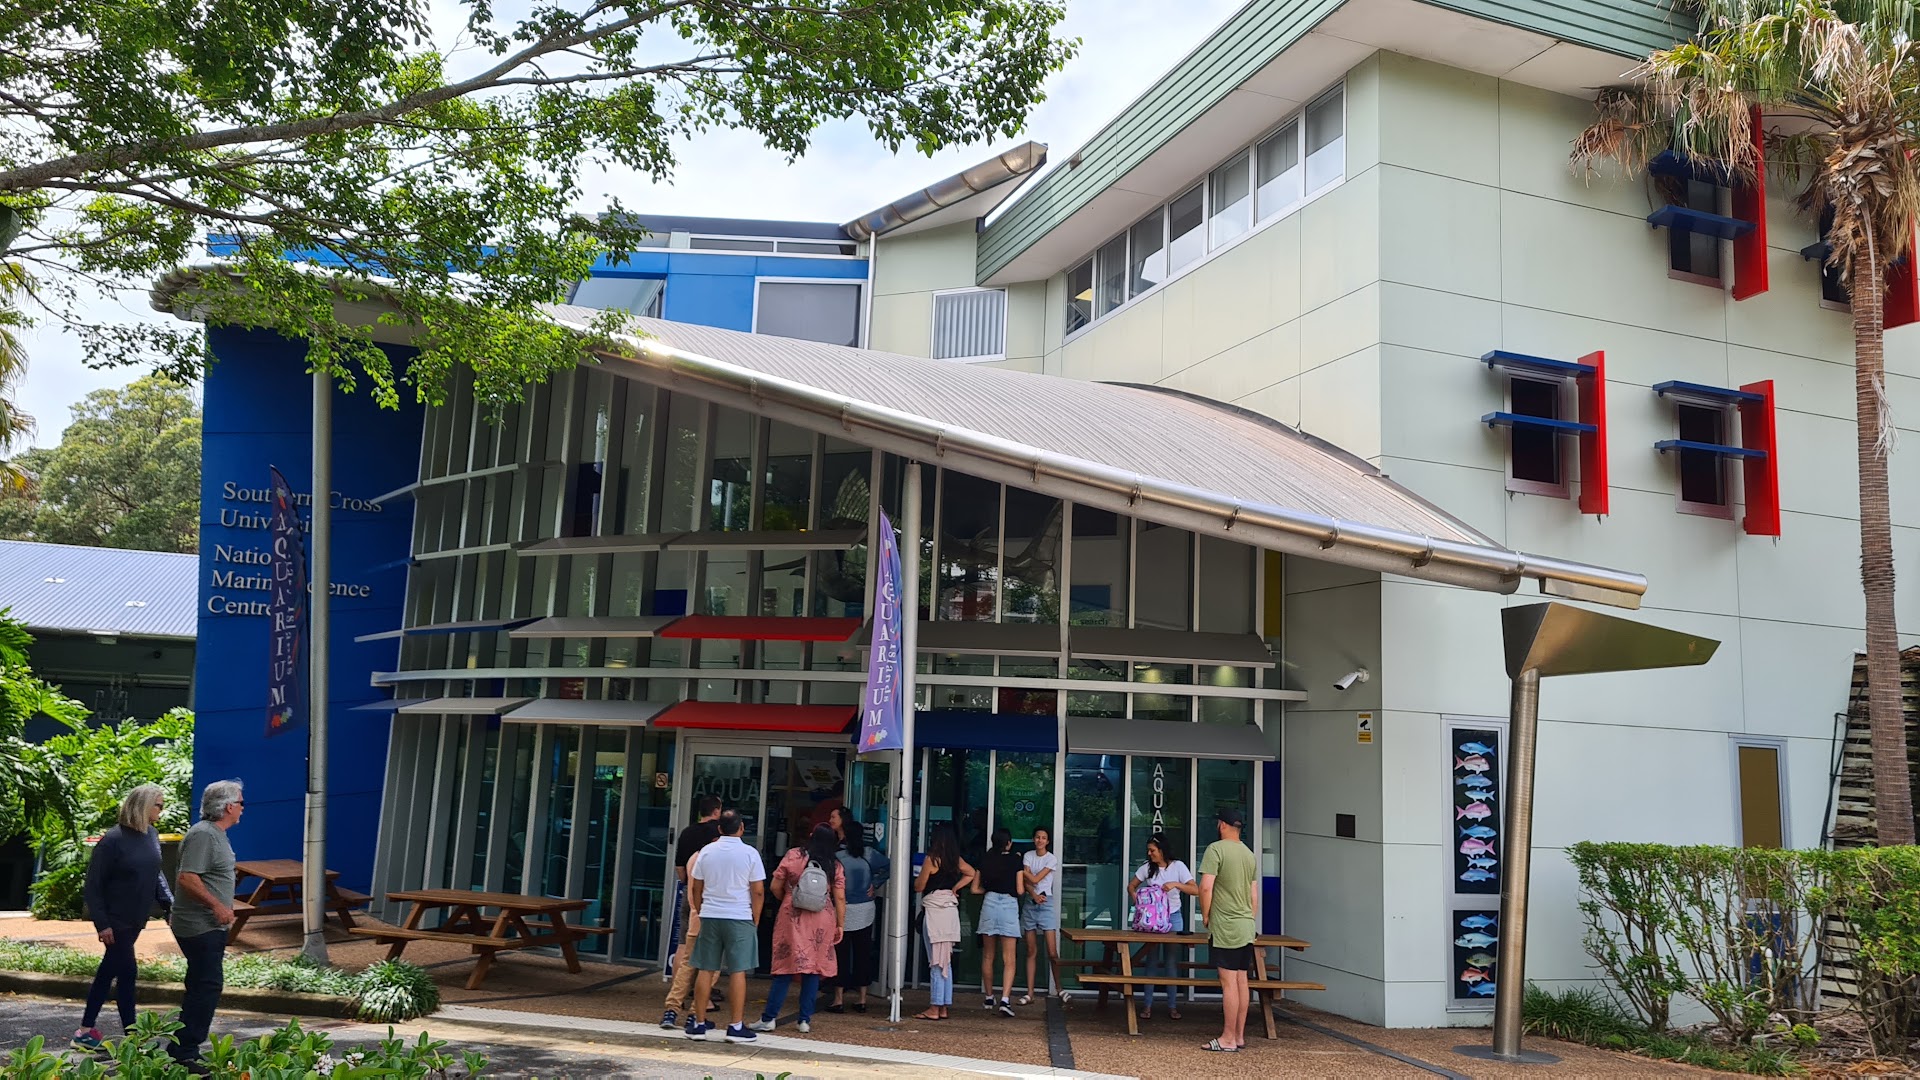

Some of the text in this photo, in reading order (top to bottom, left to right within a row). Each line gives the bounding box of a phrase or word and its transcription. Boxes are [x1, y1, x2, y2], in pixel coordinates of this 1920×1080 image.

[330, 491, 383, 512] Cross
[211, 570, 272, 591] Marin
[693, 776, 760, 802] AQUA
